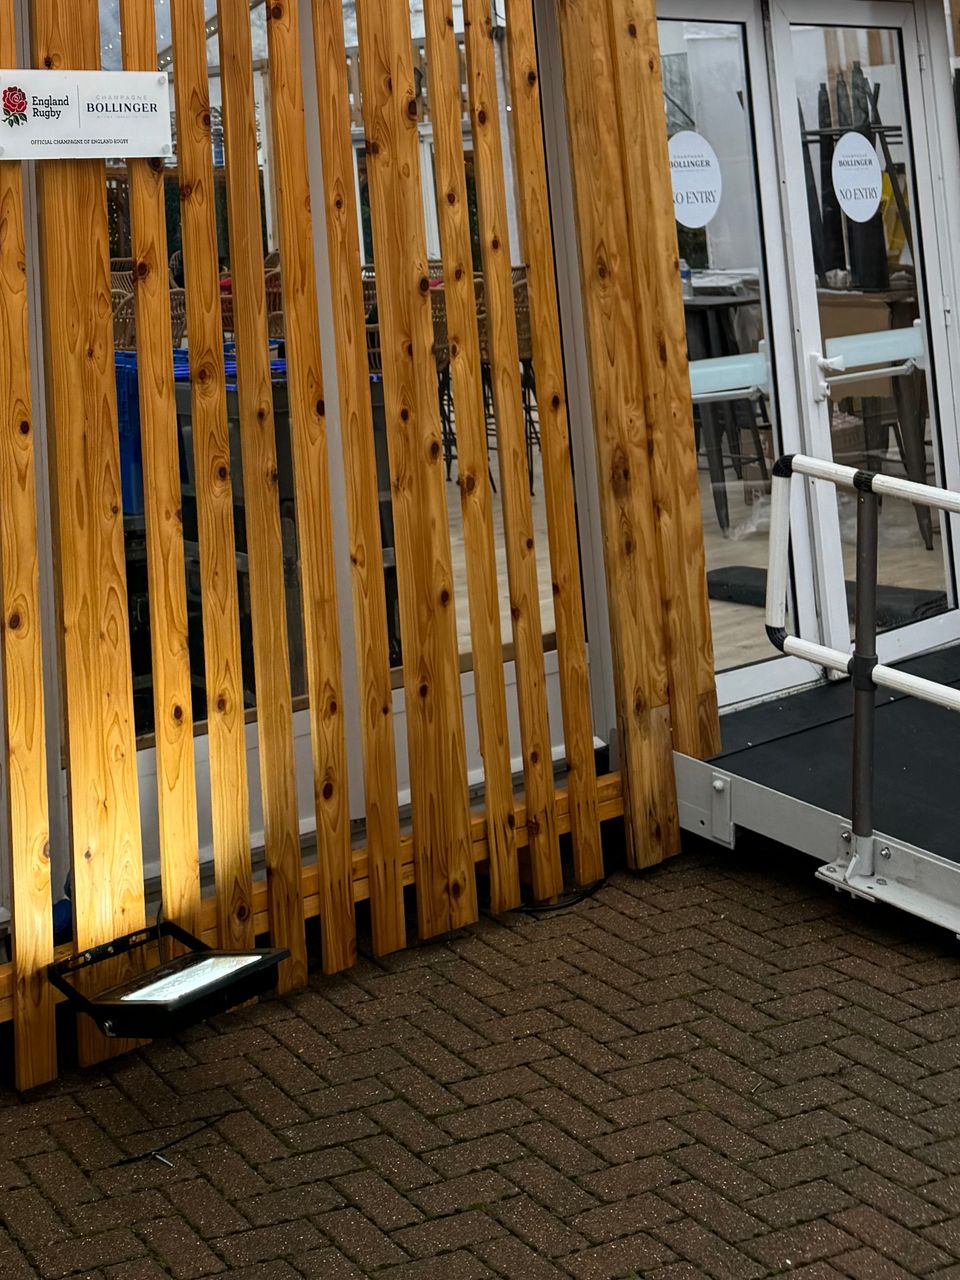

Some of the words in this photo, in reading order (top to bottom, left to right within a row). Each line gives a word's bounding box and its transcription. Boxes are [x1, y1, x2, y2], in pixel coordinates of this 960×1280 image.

[31, 96, 70, 108] England
[86, 103, 158, 113] BOLLINGER
[32, 108, 62, 120] Rugby
[838, 159, 873, 167] BOLLINGER
[672, 191, 684, 205] O
[685, 190, 717, 205] ENTRY
[839, 188, 853, 201] NO
[853, 186, 879, 201] ENTRY
